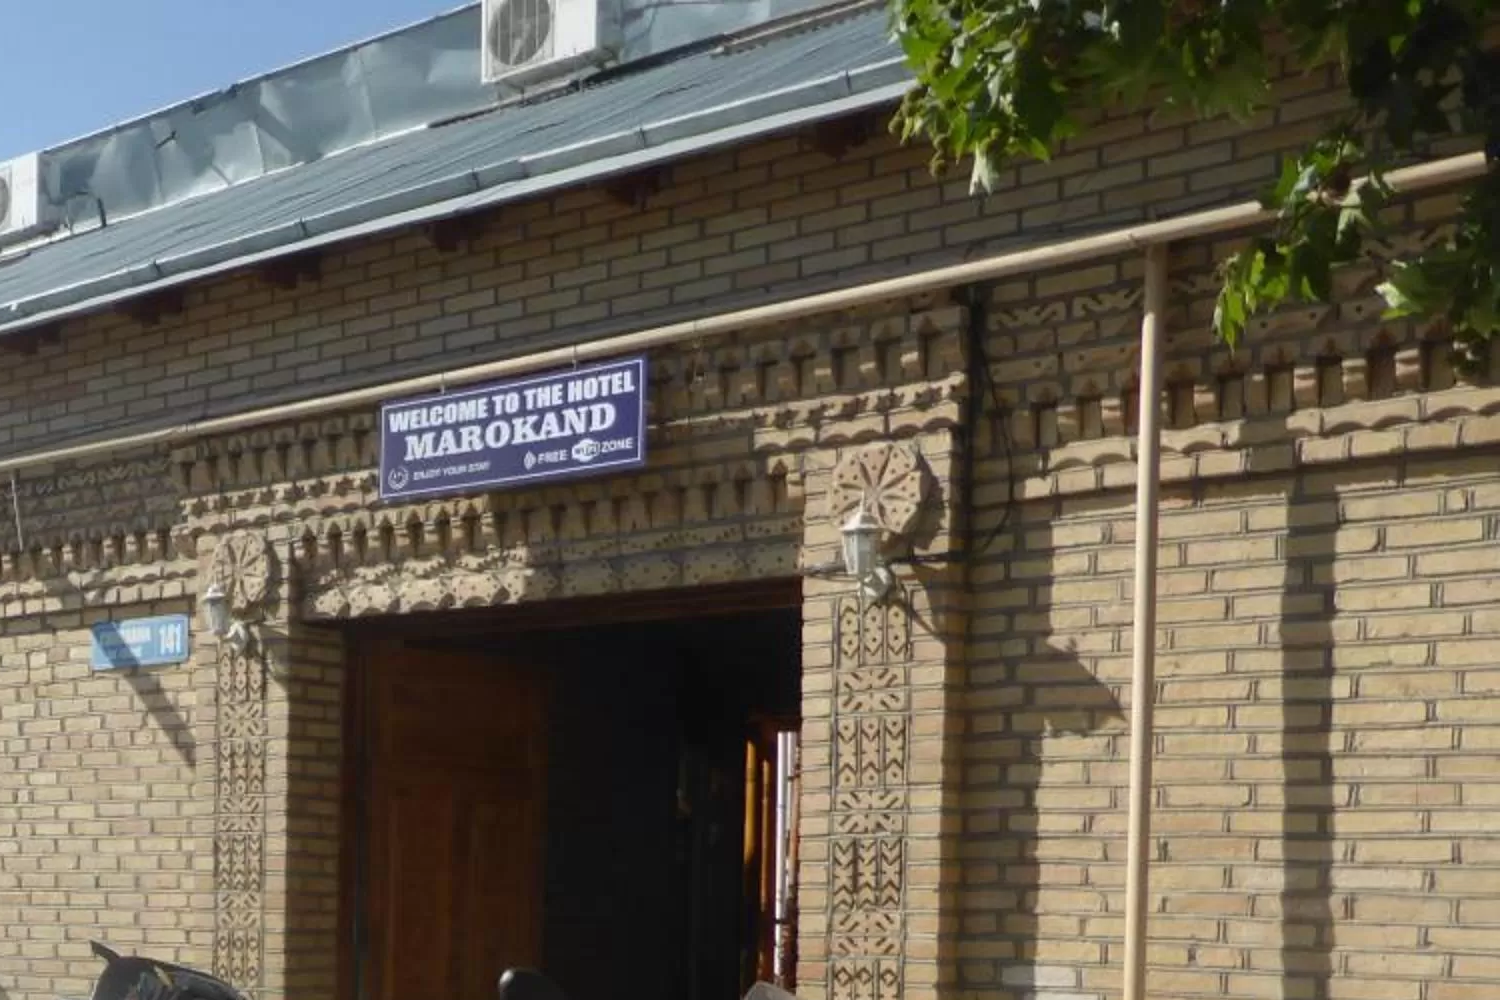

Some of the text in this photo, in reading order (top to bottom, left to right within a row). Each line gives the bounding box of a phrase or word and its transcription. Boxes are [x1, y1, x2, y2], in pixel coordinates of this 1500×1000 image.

[389, 370, 635, 433] WELCOME TO THE HOTEL
[403, 402, 616, 461] MAROKAND
[537, 449, 569, 464] FREE
[601, 437, 634, 453] ZONE
